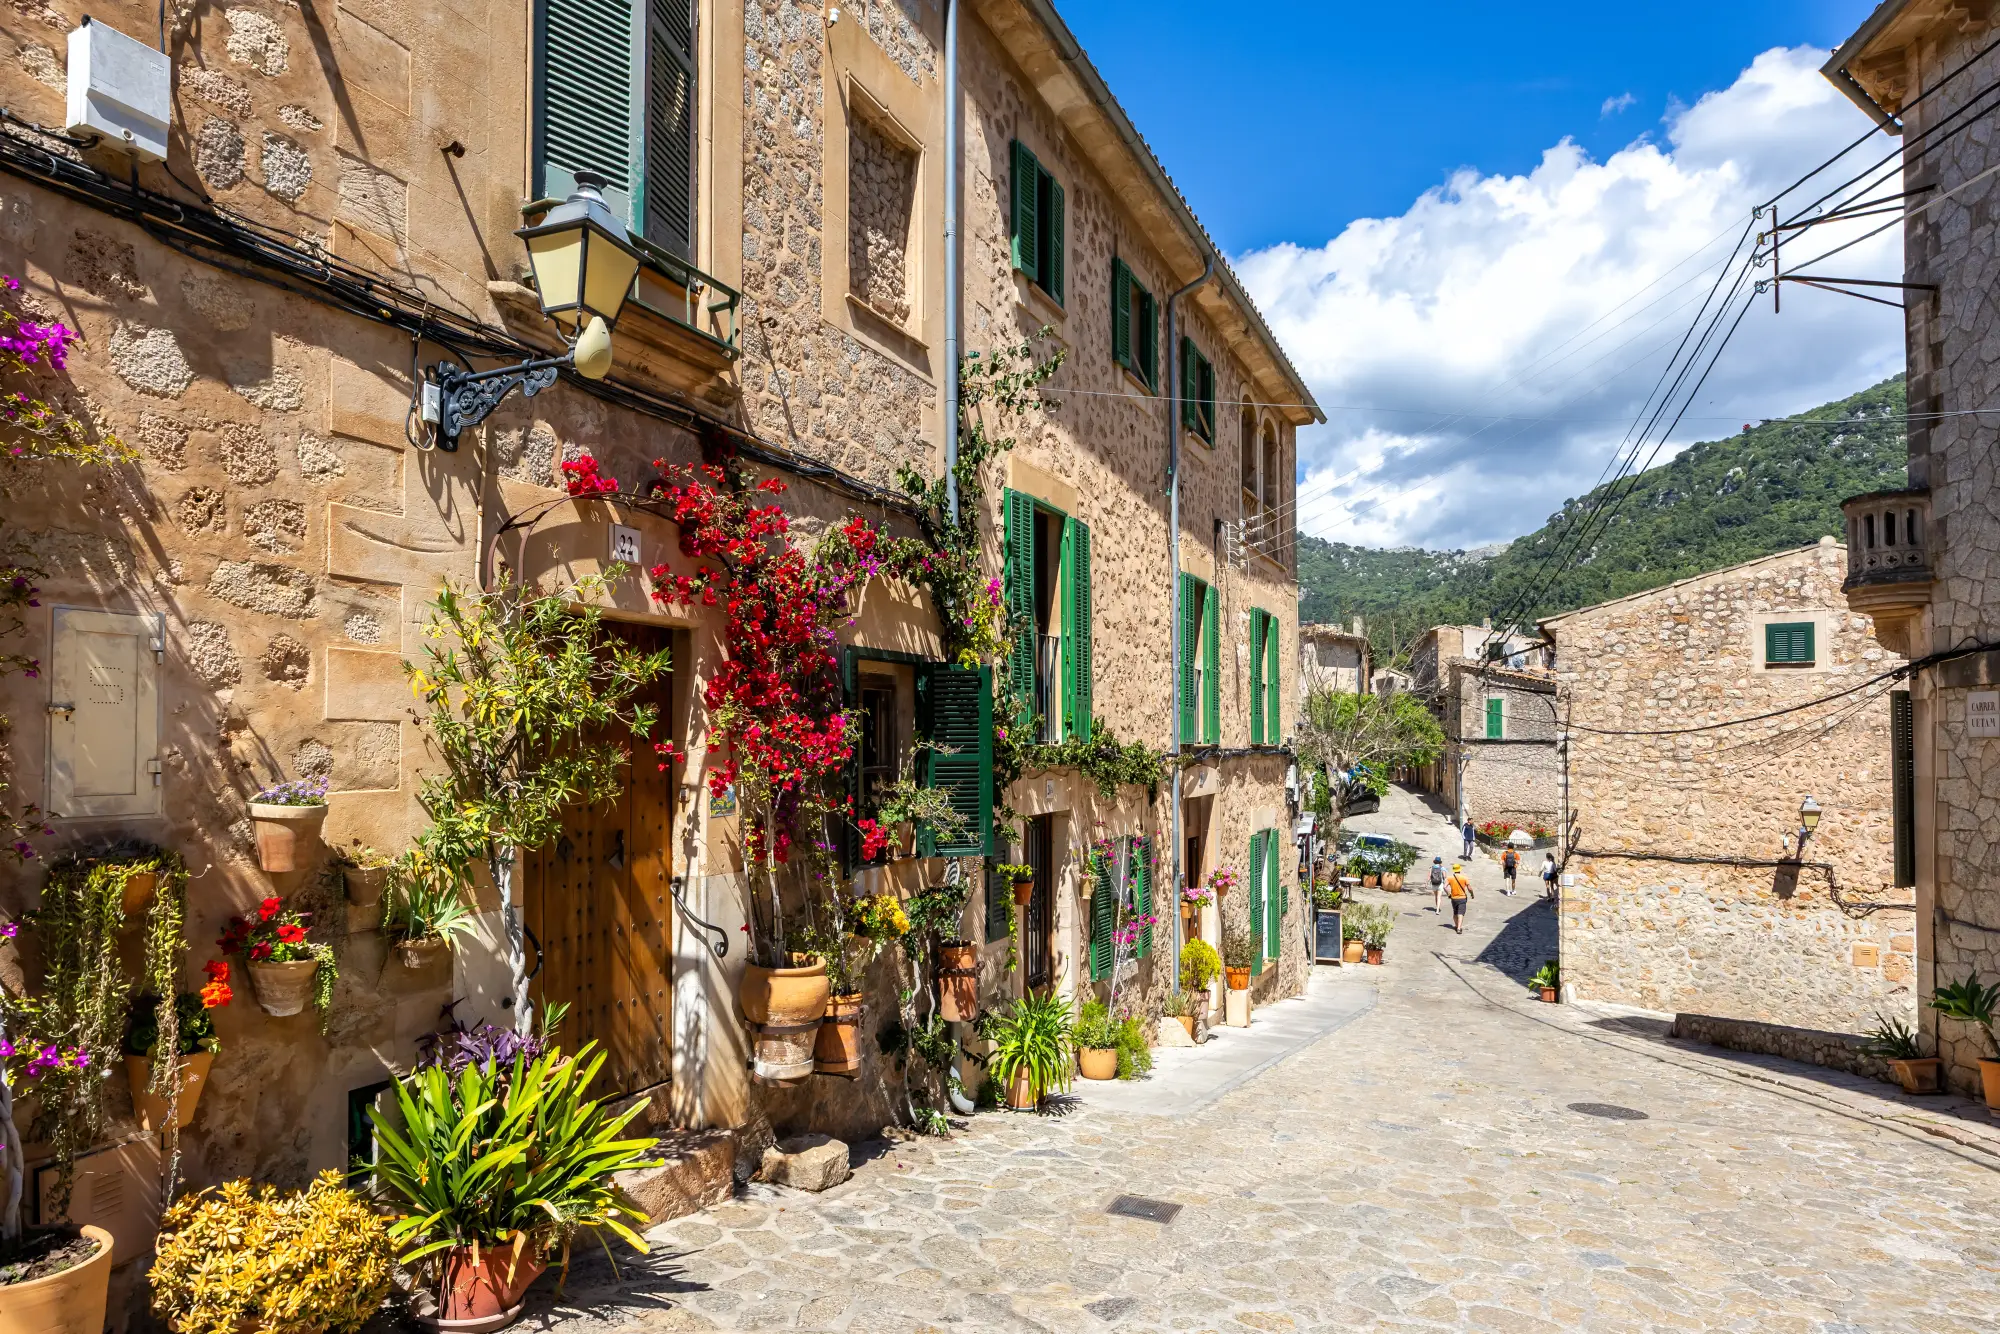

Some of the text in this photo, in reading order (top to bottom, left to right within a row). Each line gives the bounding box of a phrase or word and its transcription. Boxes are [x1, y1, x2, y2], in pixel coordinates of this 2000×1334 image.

[620, 534, 633, 555] 22
[1971, 701, 1996, 711] CARRER
[1971, 717, 1996, 728] UETAM
